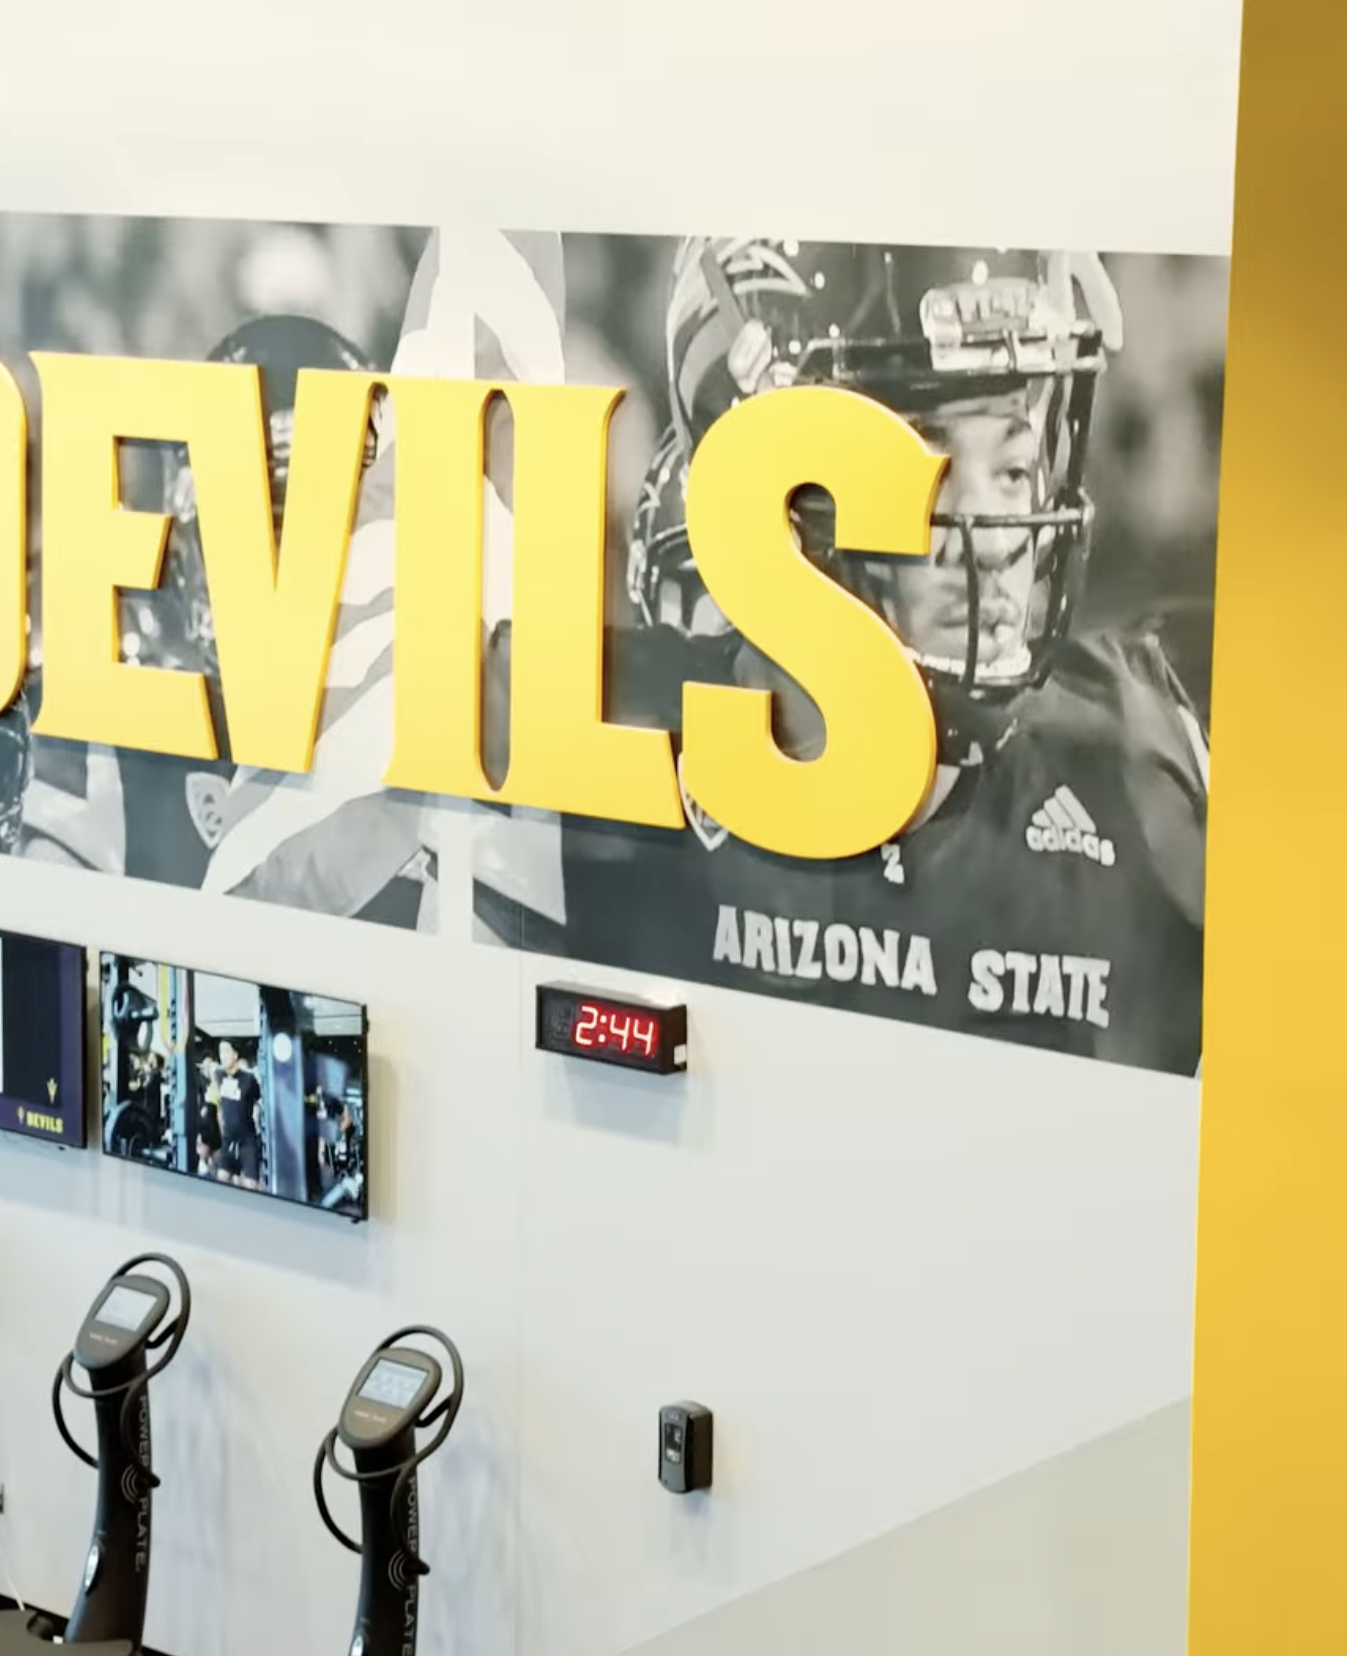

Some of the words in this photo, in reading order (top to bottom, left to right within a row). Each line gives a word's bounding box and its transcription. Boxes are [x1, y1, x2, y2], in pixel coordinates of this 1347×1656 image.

[1026, 826, 1116, 867] adidas
[713, 904, 937, 996] ARIZONA
[968, 949, 1111, 1028] STATE
[575, 1005, 654, 1056] 2:44
[26, 1111, 64, 1134] DEVILS
